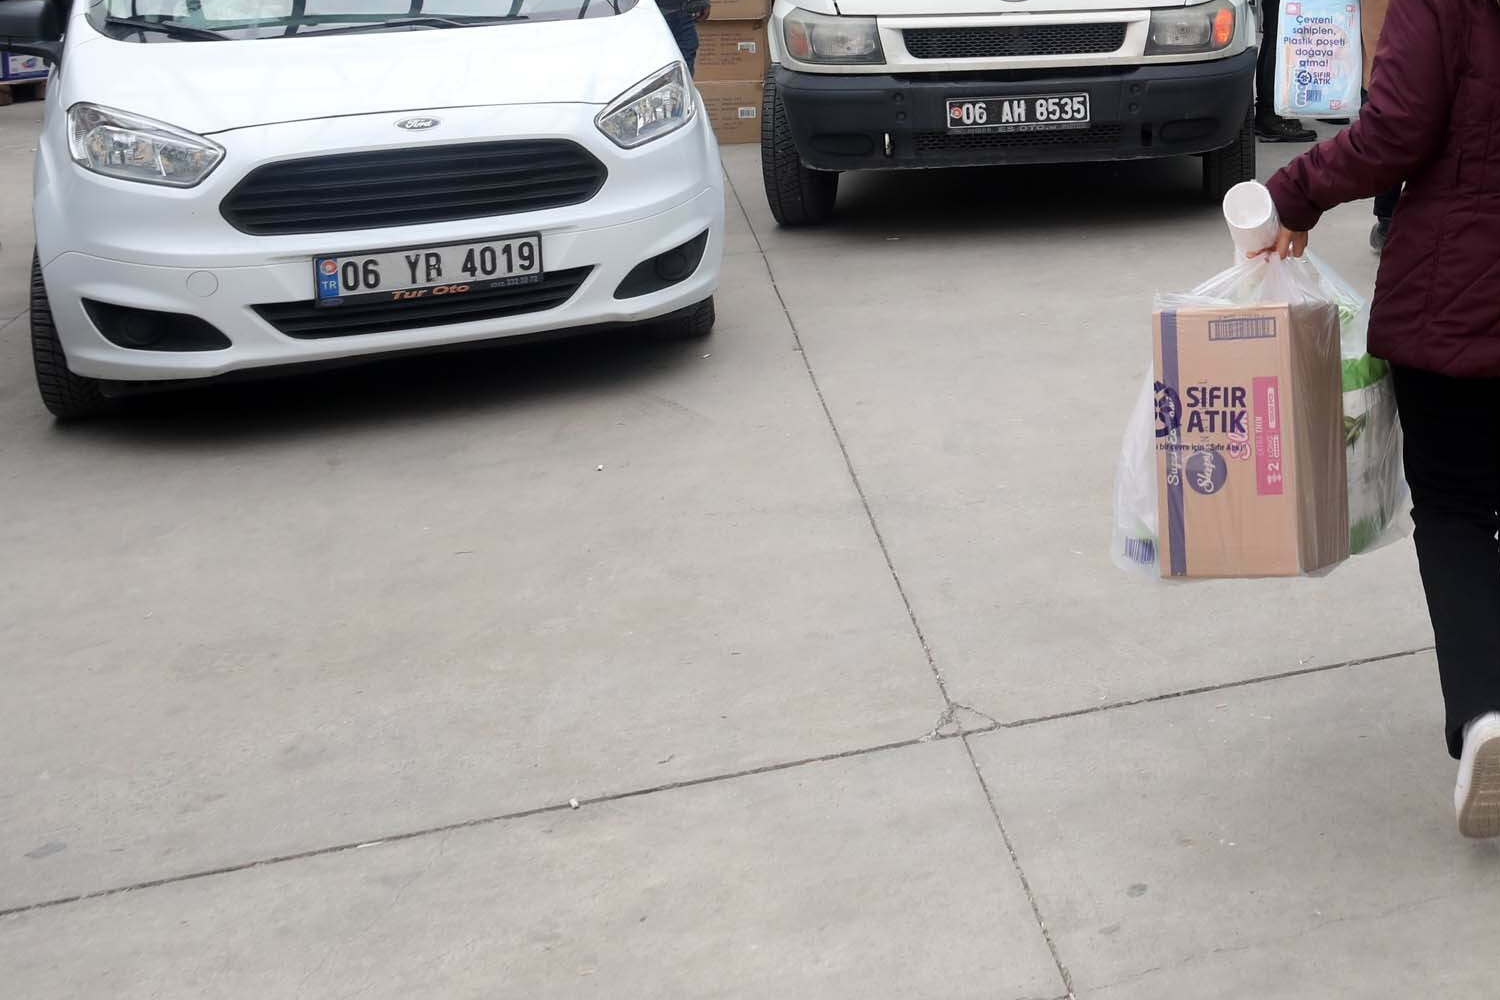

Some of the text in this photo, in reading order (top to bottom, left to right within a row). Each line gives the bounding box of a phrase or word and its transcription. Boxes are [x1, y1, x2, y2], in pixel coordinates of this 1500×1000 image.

[1296, 15, 1333, 25] Çevreni
[1293, 27, 1336, 36] sahiplen,
[1283, 37, 1345, 47] Plastik poşeti
[1295, 48, 1334, 57] doğaya
[1299, 59, 1328, 67] atma!
[961, 97, 1086, 124] 06 AH 8535
[341, 258, 381, 291] 06
[461, 241, 535, 277] 4019
[321, 280, 337, 291] TR
[391, 284, 470, 300] Tur Oto
[1186, 386, 1247, 408] SIFIR
[1187, 410, 1247, 433] ATIK
[1268, 462, 1280, 471] 2
